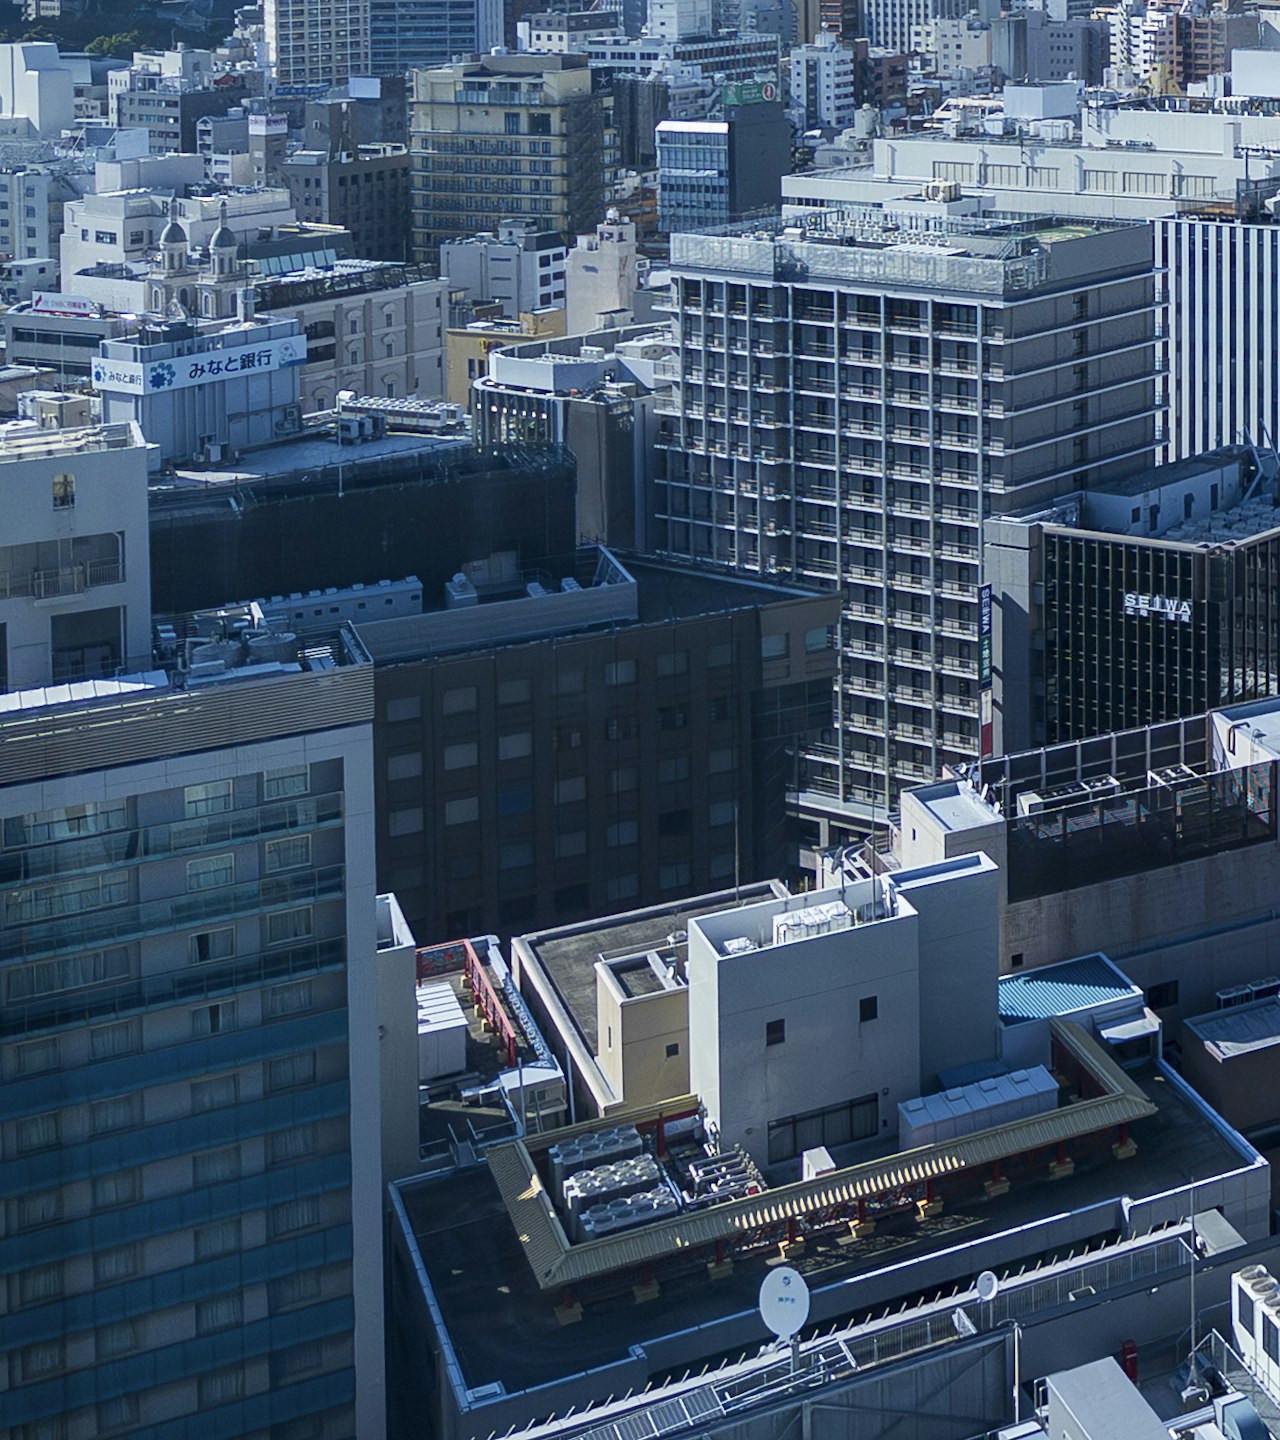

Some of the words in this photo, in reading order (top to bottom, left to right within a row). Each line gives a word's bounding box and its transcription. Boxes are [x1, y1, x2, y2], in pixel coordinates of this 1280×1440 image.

[189, 349, 273, 379] みなと銀行
[108, 371, 142, 386] みなと銀行
